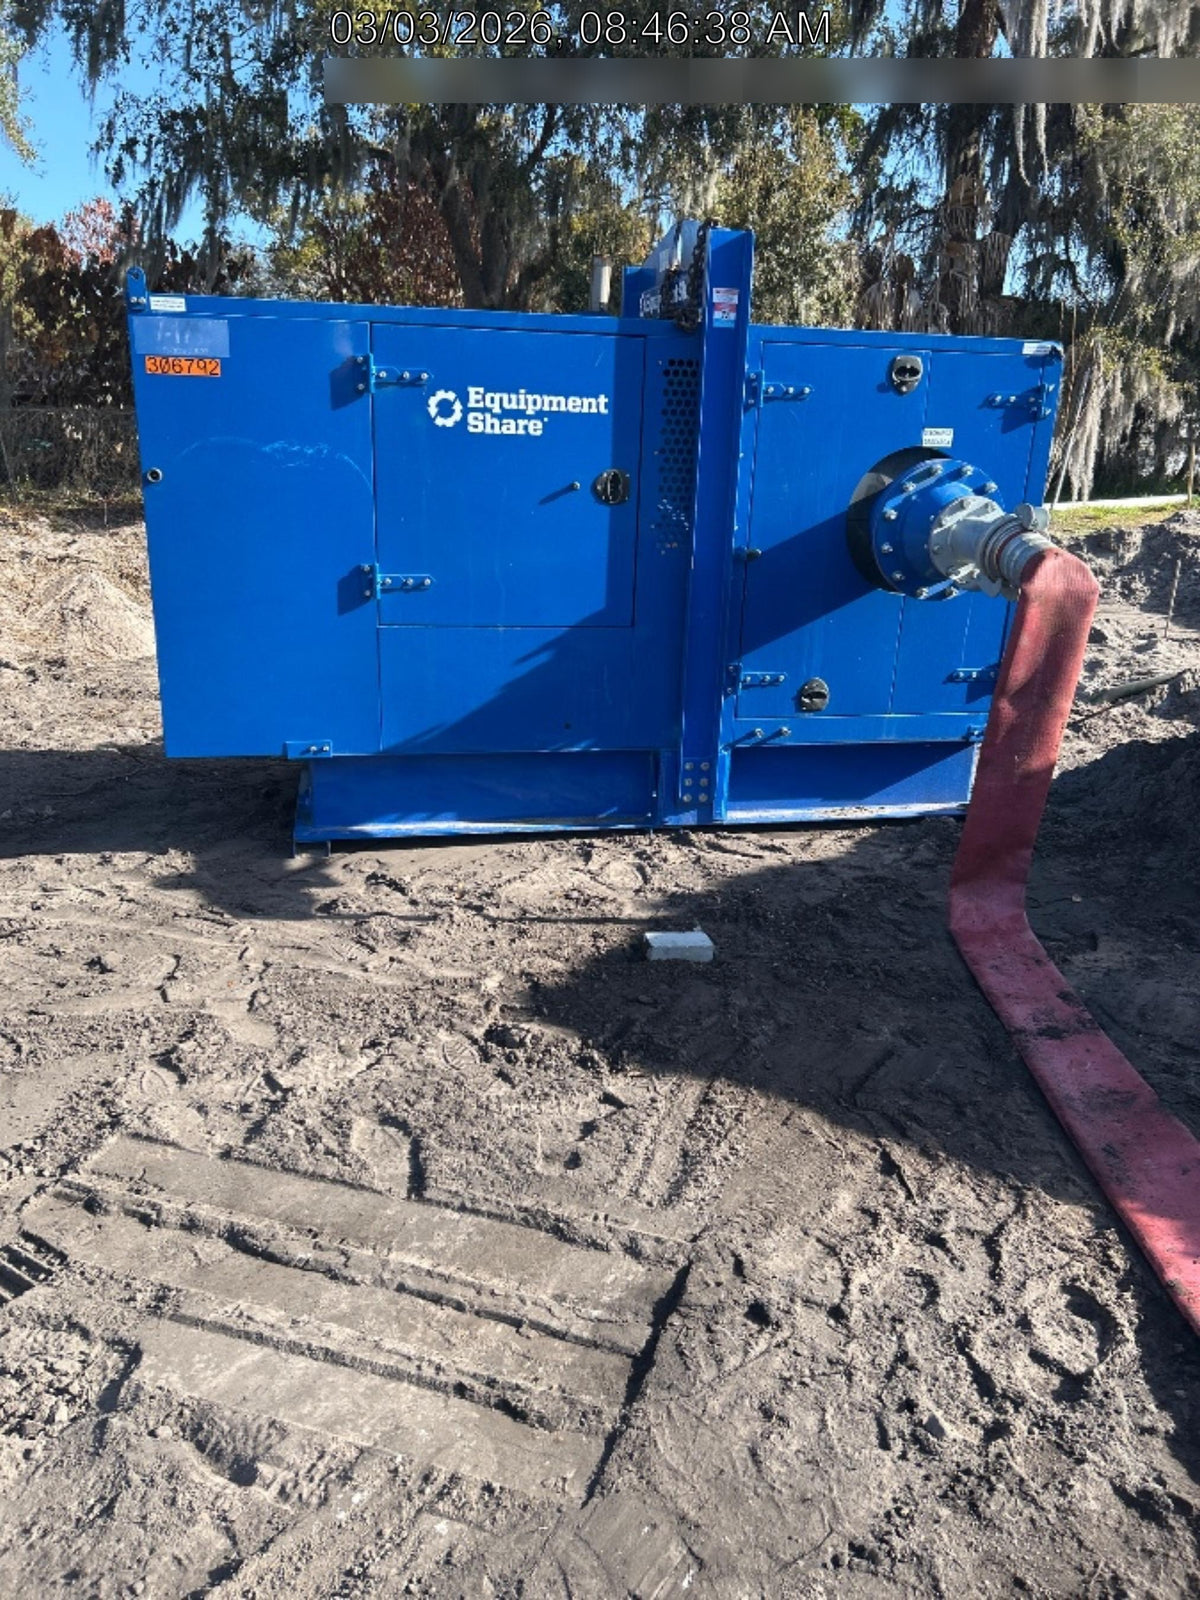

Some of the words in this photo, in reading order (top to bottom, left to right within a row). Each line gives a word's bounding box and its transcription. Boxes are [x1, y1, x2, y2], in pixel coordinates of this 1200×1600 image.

[146, 356, 220, 376] 306792
[467, 386, 609, 415] Equipment
[467, 412, 543, 436] Share
